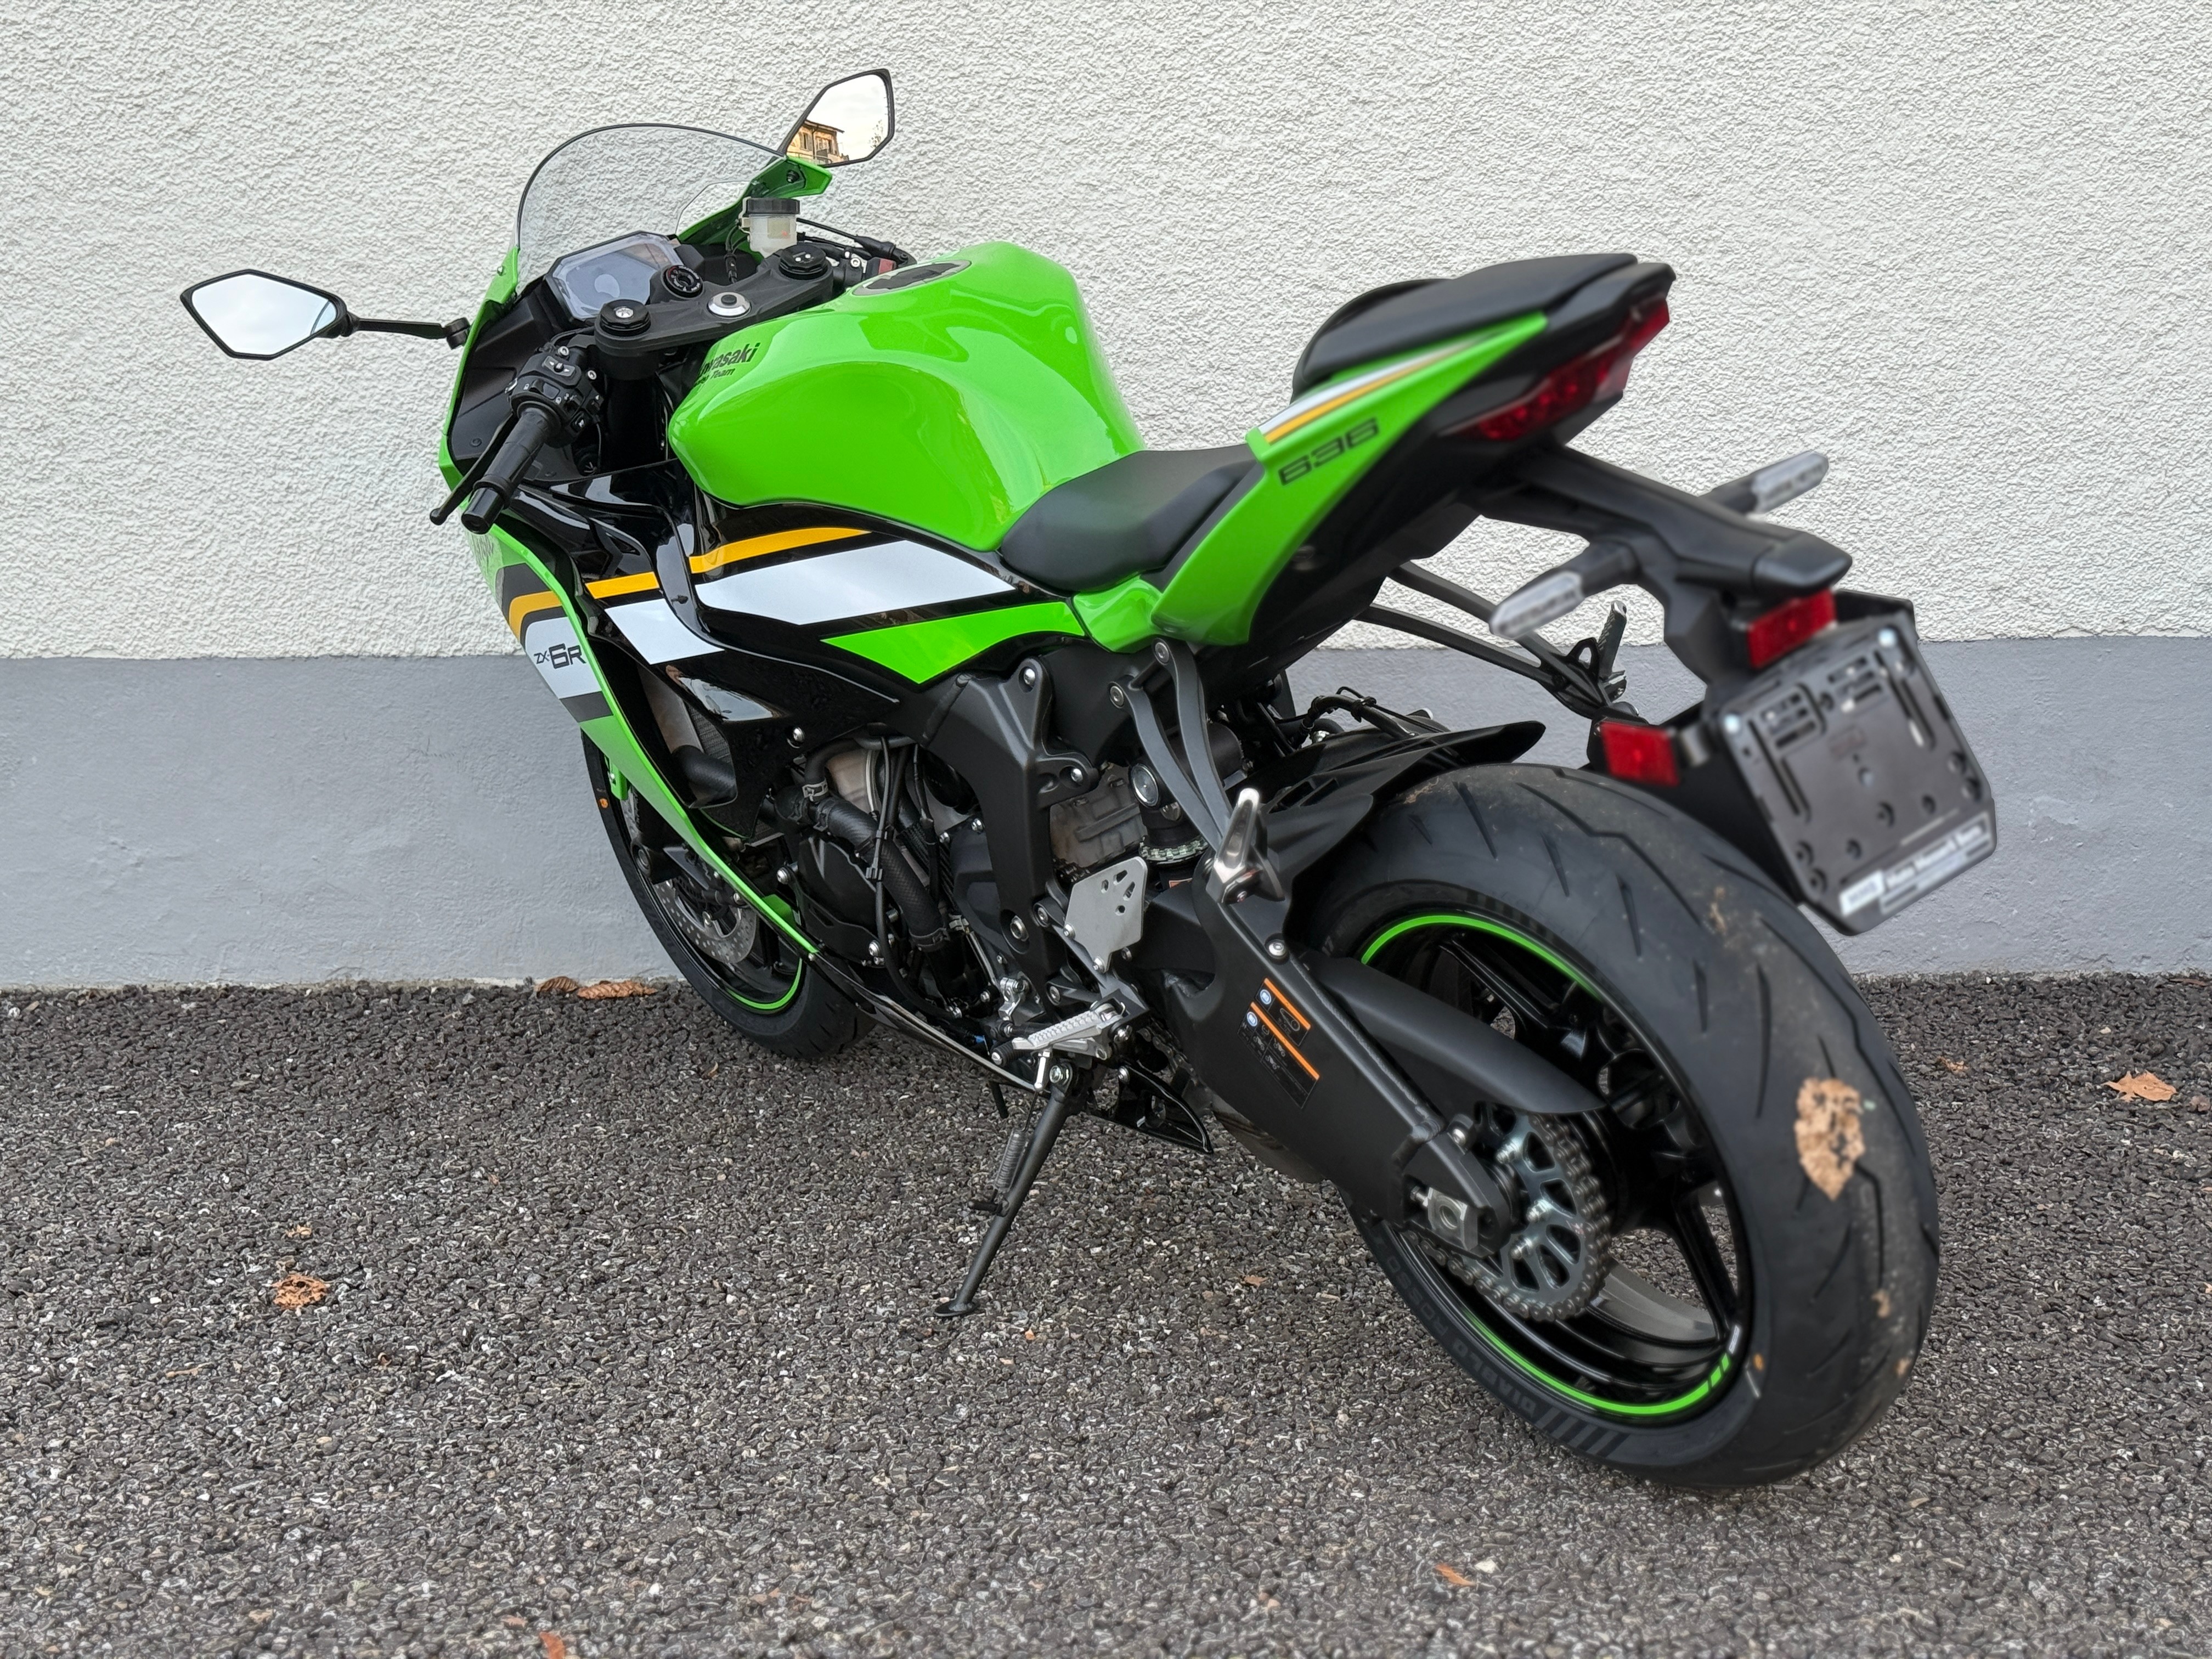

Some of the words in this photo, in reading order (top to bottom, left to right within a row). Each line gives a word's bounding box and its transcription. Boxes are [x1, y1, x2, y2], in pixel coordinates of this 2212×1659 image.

[699, 342, 761, 377] wasaki
[710, 368, 736, 380] Team
[1279, 419, 1378, 485] 636
[1387, 1255, 1448, 1336] ROSSO
[1454, 1339, 1537, 1412] DIABLO
